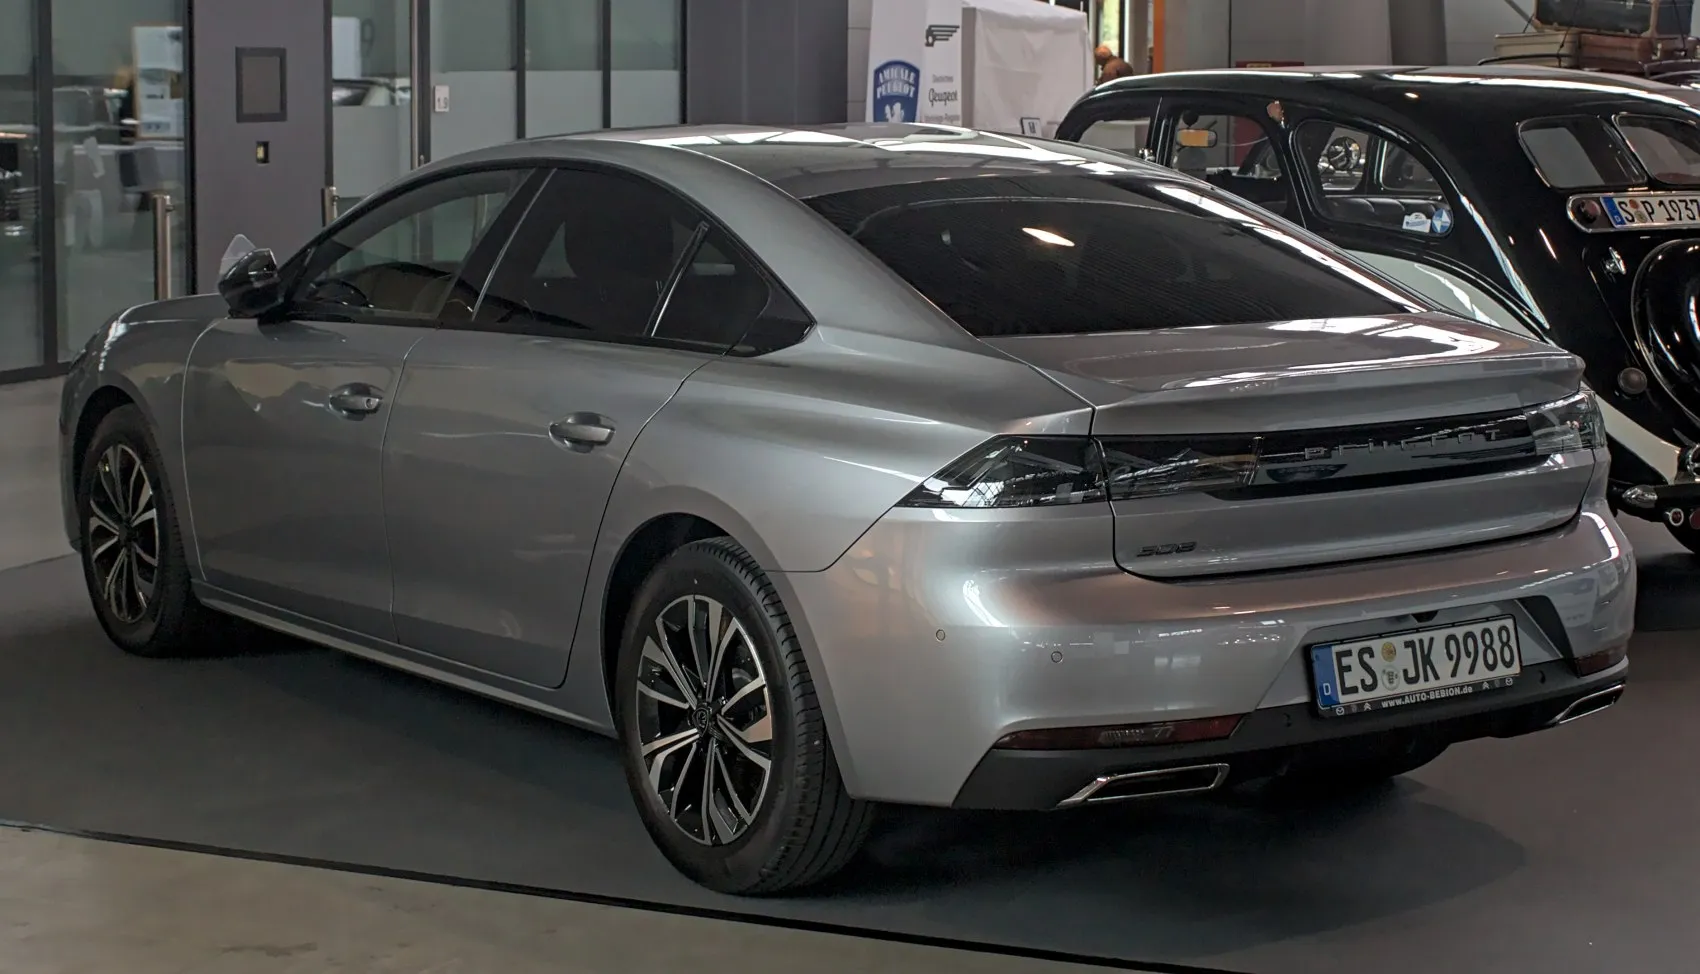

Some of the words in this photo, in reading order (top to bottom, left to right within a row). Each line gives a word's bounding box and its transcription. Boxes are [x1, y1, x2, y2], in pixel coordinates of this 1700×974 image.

[878, 67, 916, 84] AMICALE
[877, 82, 916, 99] PEUGEOT
[1618, 201, 1635, 223] S
[1640, 201, 1655, 222] P
[1658, 199, 1700, 221] 1937
[1335, 646, 1379, 696] ES
[1403, 636, 1441, 686] JK
[1445, 625, 1515, 679] 9988
[1323, 683, 1332, 696] D
[1381, 686, 1474, 709] www.AUTO-BEBION.de
